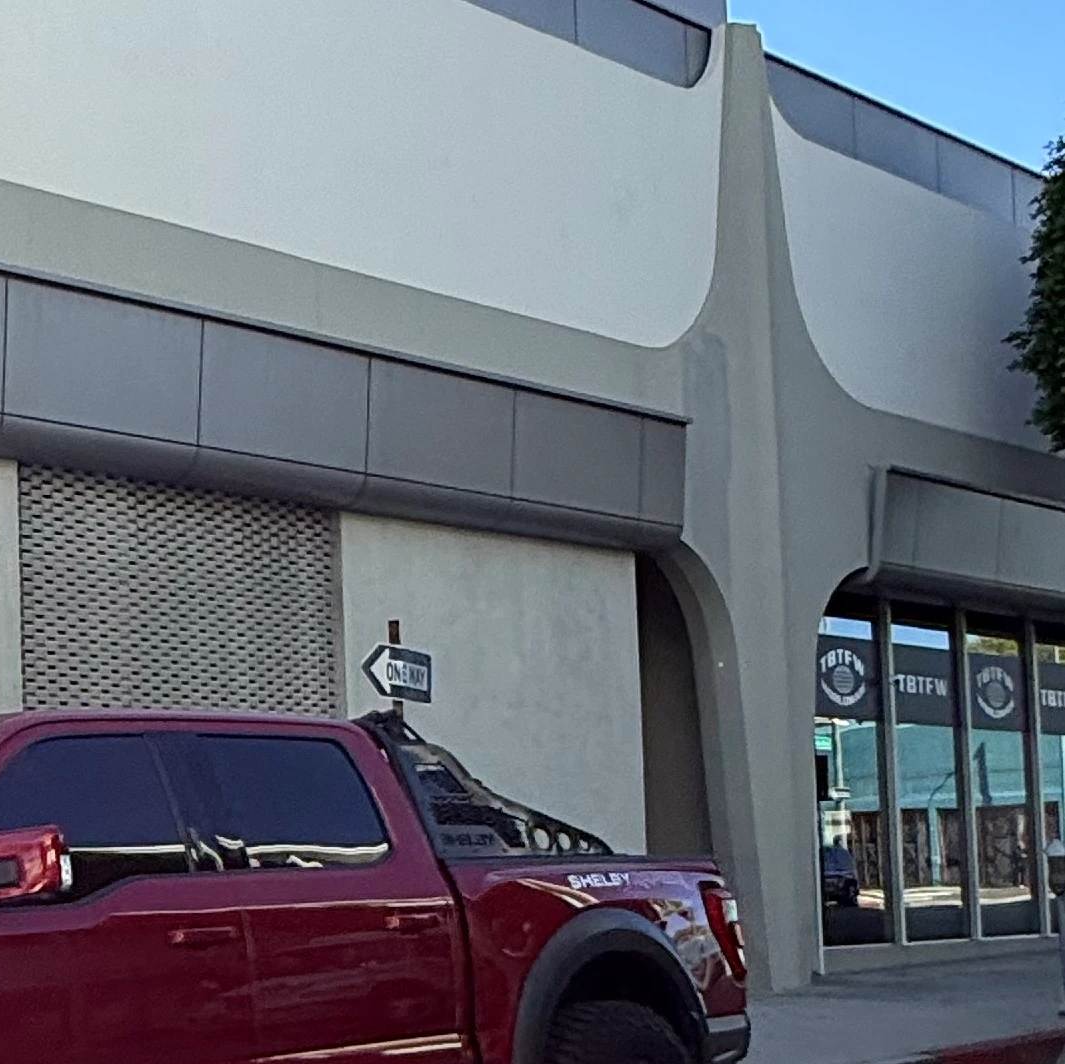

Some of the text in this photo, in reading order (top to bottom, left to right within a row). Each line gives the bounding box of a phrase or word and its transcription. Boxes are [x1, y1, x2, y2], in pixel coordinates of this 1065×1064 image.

[386, 661, 408, 684] ONE
[819, 648, 865, 677] TBTFW
[895, 673, 948, 697] TBTFW
[1039, 689, 1065, 708] TBT
[567, 872, 630, 890] SHELBY
